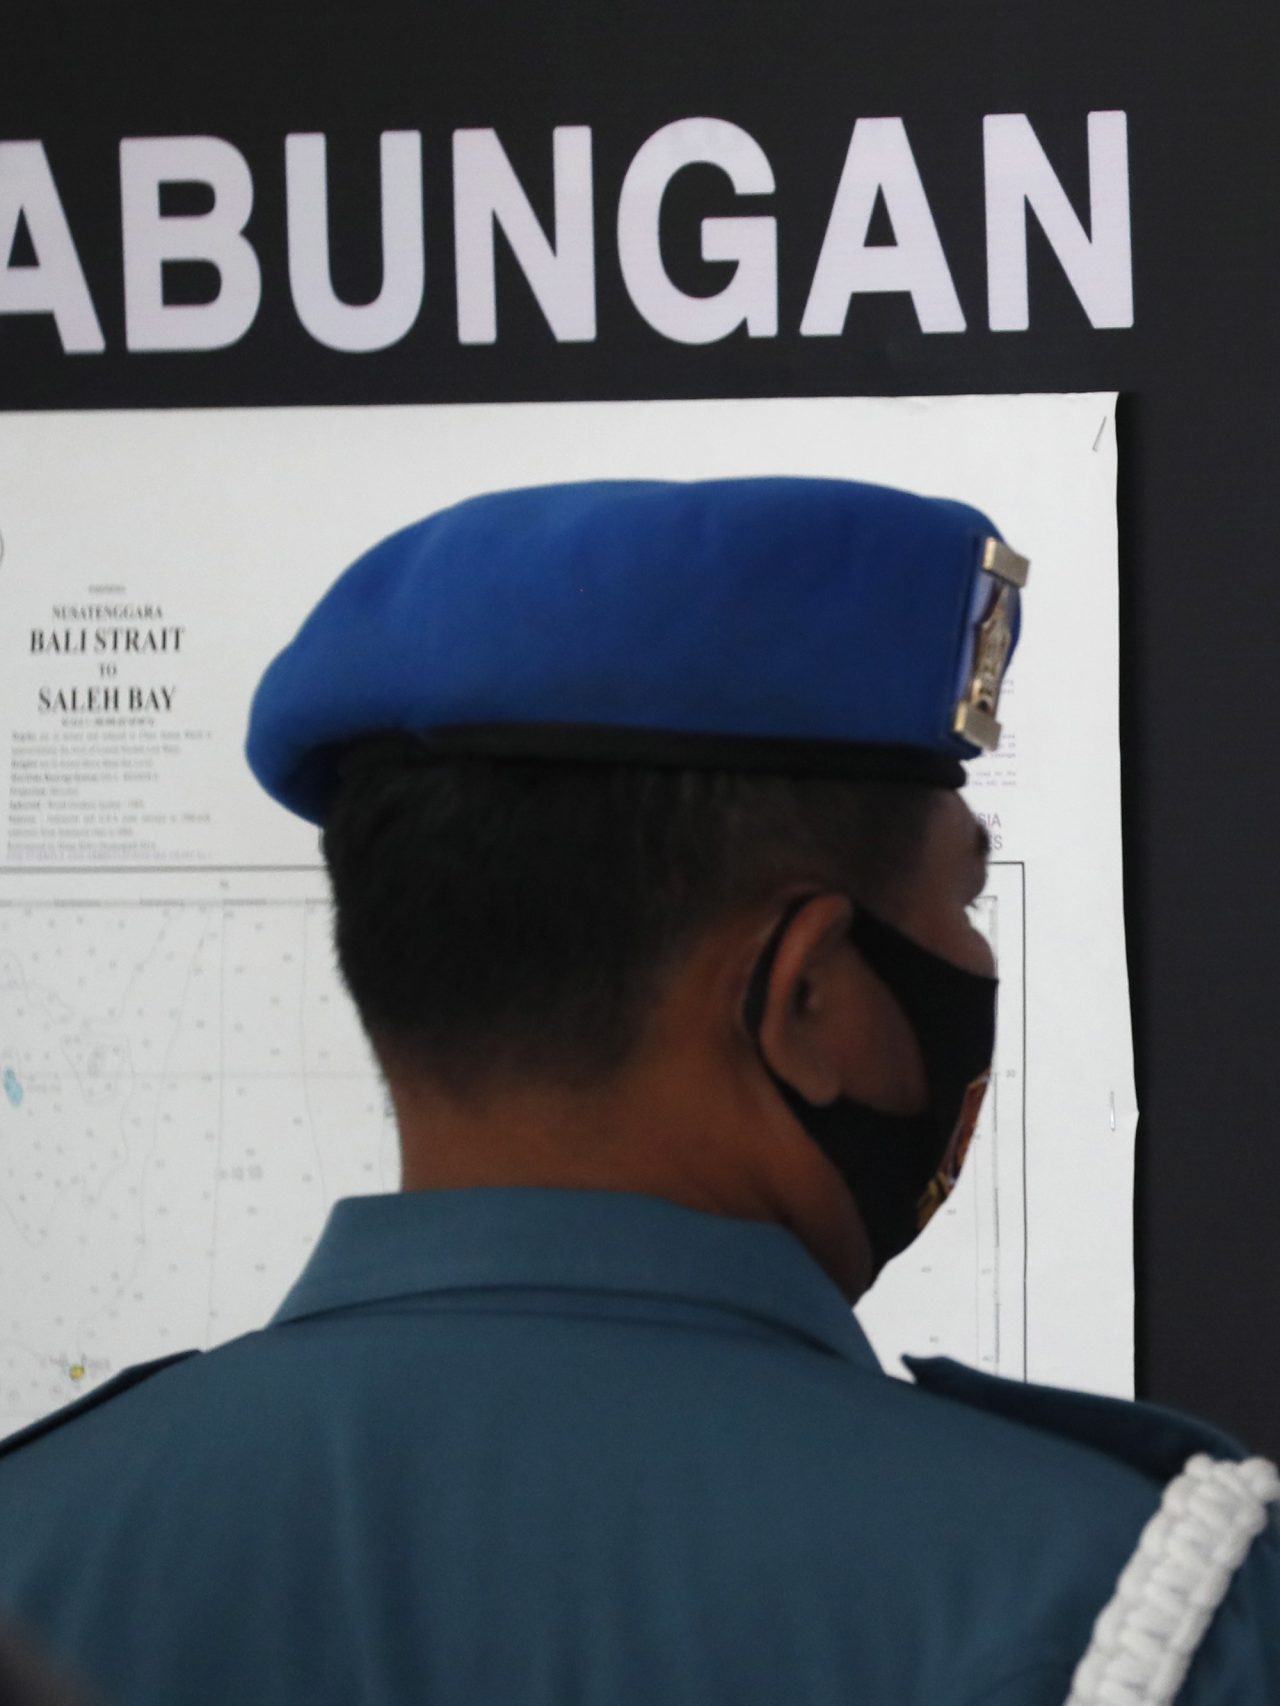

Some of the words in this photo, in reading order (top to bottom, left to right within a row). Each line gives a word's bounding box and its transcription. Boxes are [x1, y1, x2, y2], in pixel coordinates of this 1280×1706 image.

[29, 627, 87, 654] BALI
[94, 626, 185, 654] STRAIT
[99, 662, 118, 677] TO
[38, 686, 119, 713] SALEH
[128, 685, 177, 712] BAY
